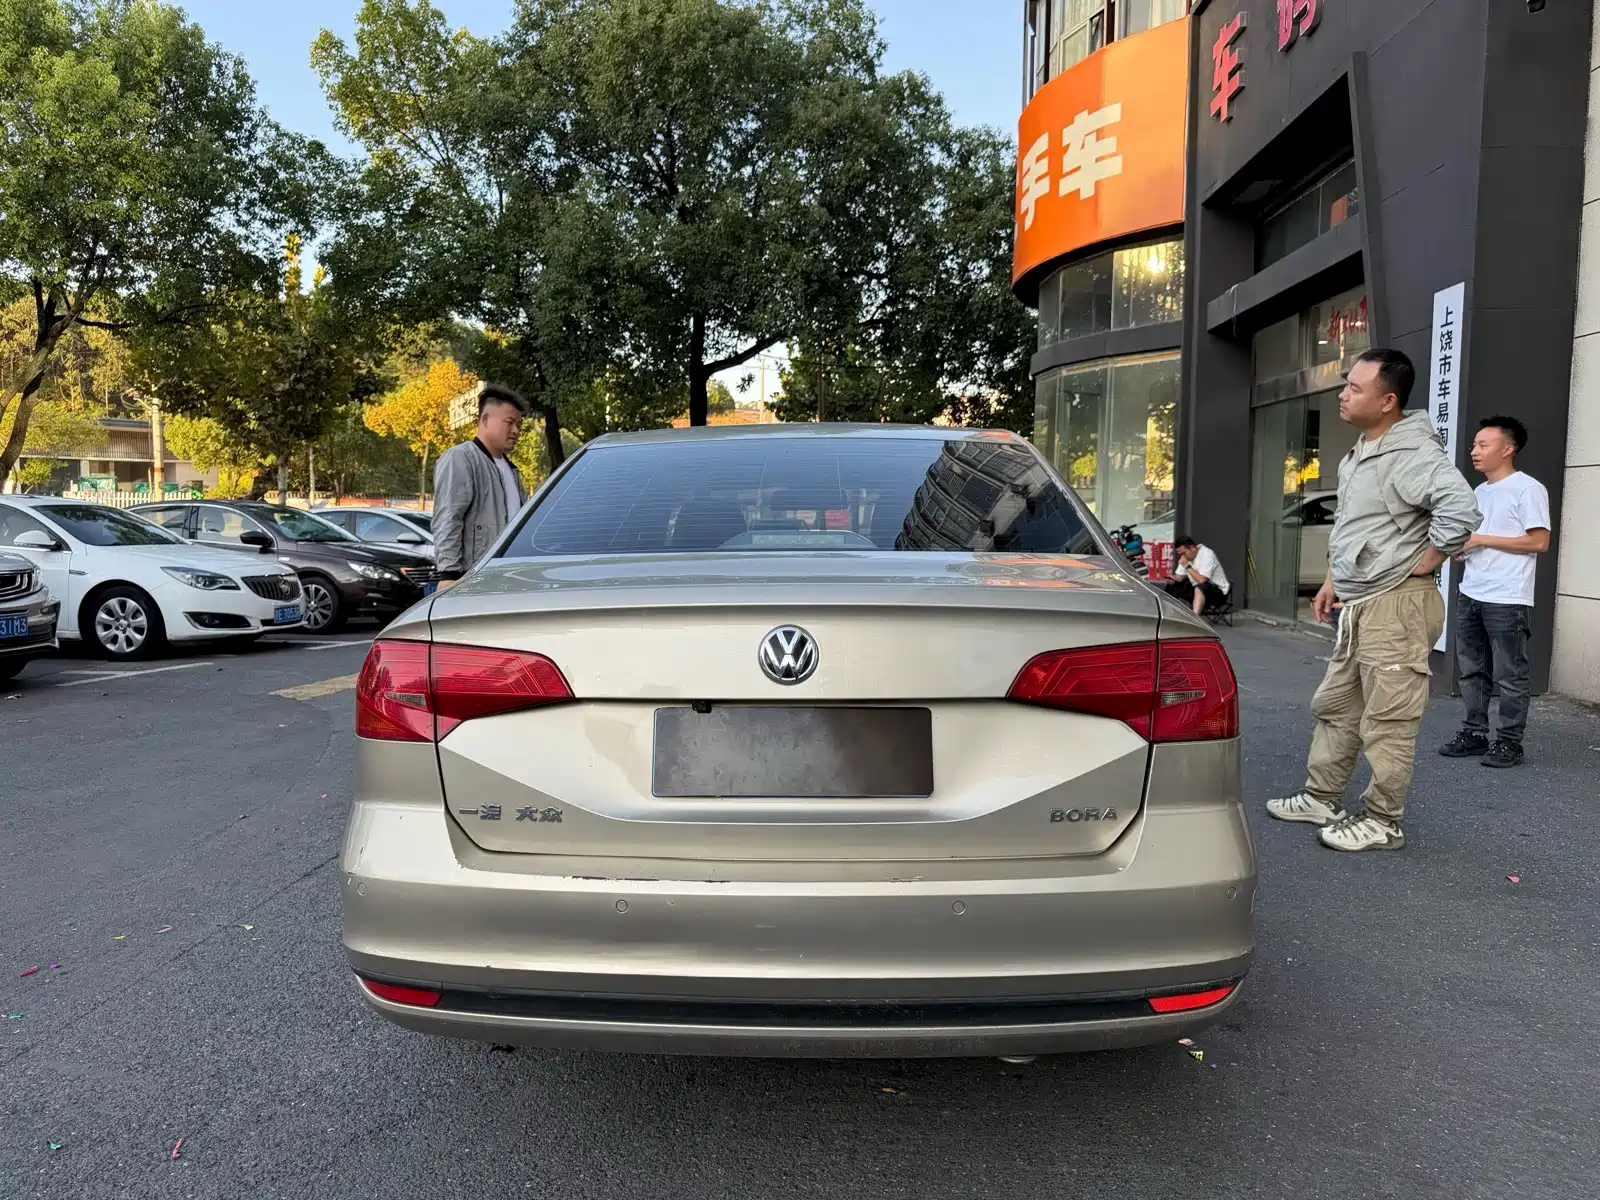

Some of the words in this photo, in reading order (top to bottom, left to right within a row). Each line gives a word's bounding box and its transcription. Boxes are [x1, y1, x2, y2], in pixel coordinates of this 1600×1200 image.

[1015, 102, 1123, 238] 手车
[1436, 305, 1454, 454] 上饶市车易淘
[515, 805, 563, 823] 大众
[1049, 807, 1118, 823] BORA
